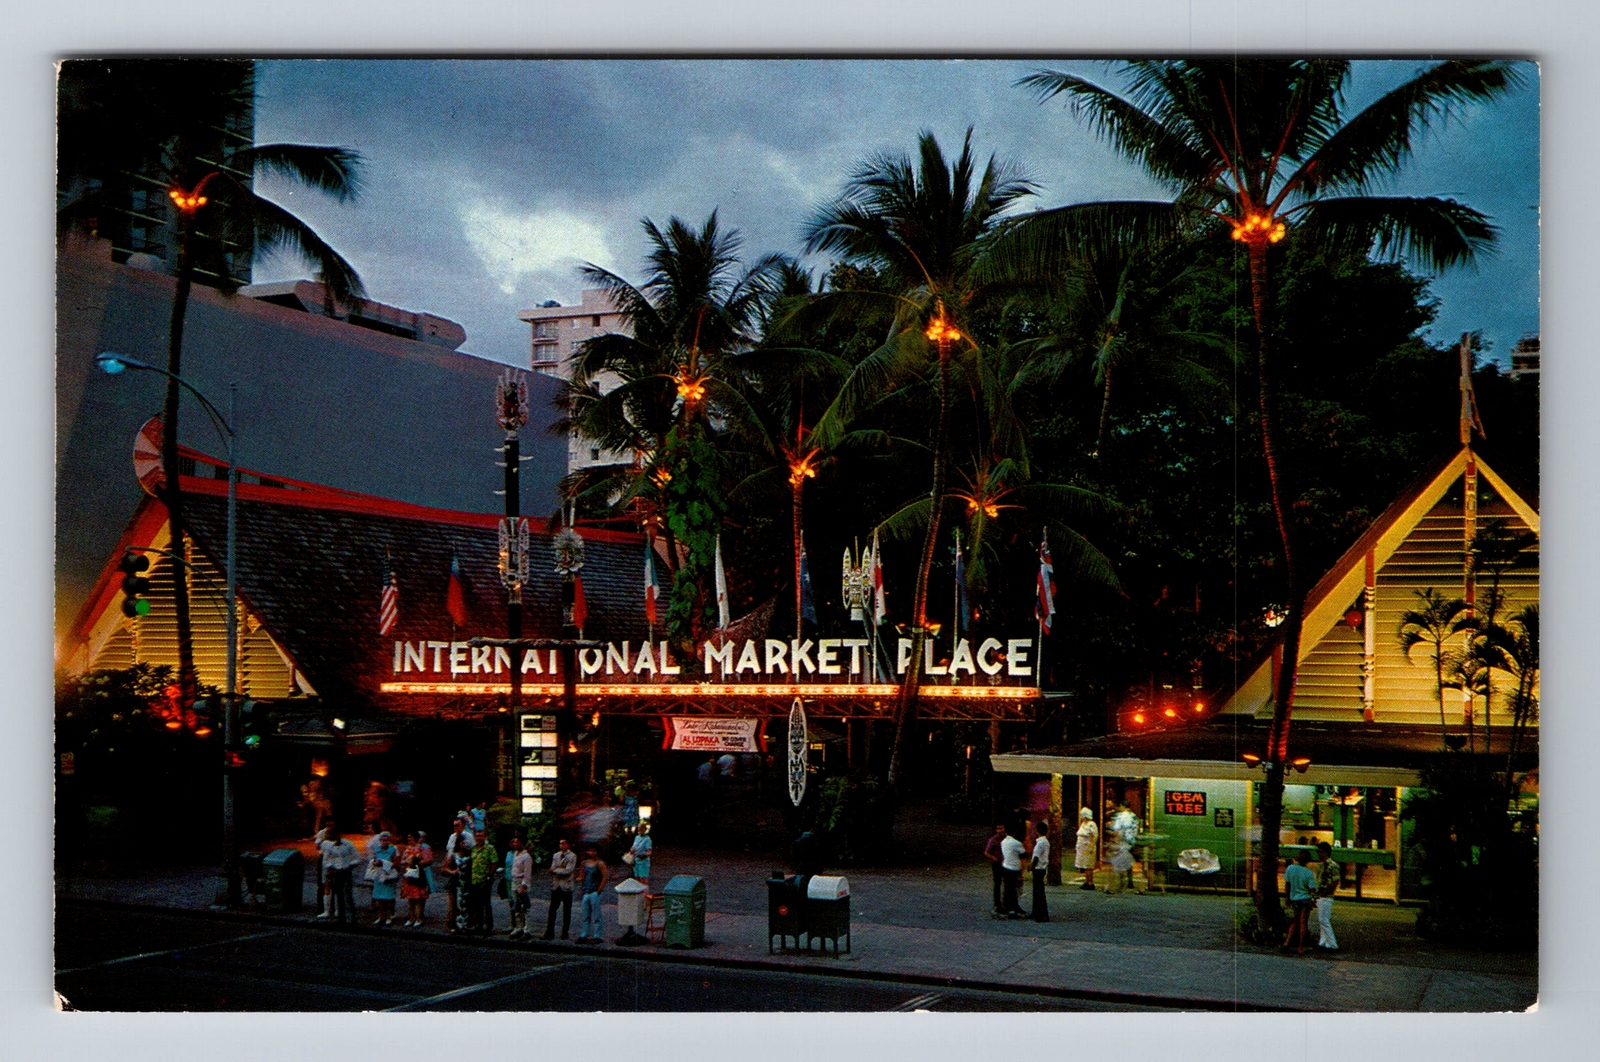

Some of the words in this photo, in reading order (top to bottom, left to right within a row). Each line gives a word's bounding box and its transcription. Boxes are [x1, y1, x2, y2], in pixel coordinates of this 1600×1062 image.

[393, 640, 681, 675] INTERNATONAL
[704, 638, 869, 675] MARKET
[896, 637, 1033, 677] PLACE
[1172, 792, 1204, 803] GEM
[1166, 803, 1204, 814] TREE
